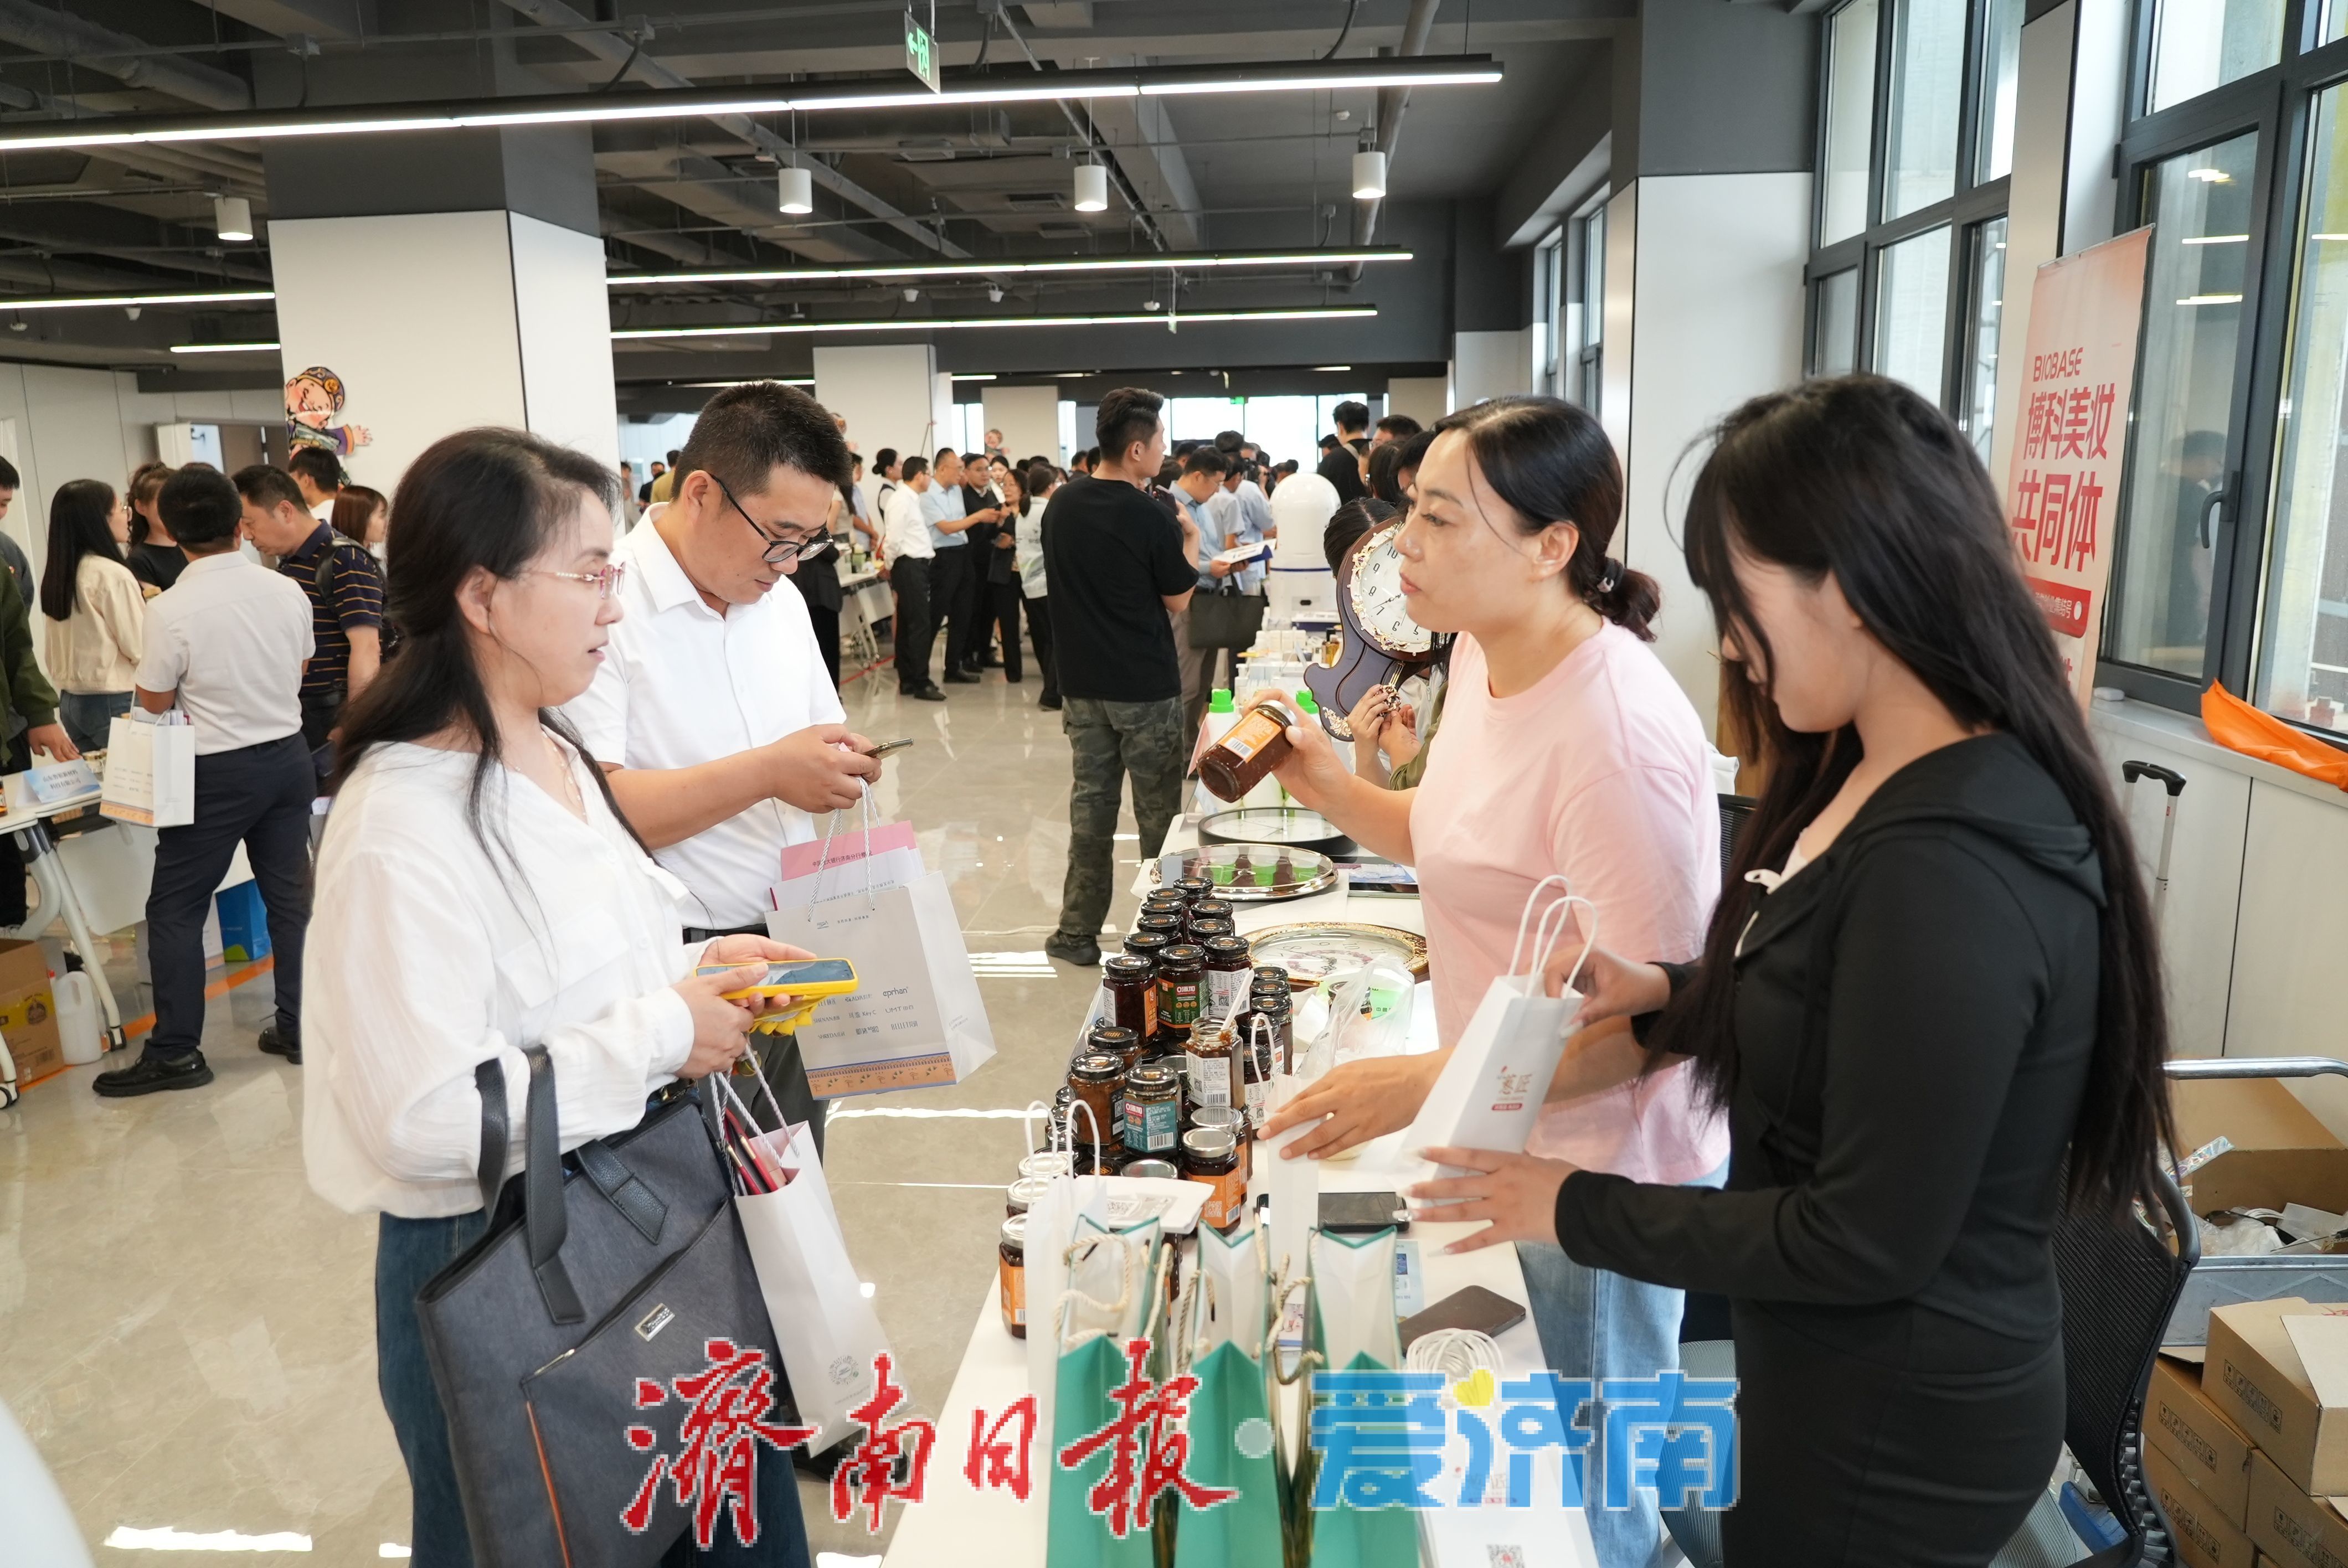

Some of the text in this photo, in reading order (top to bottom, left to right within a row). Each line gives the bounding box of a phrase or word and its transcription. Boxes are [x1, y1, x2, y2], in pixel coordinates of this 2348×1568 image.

[2033, 347, 2084, 383] BIOBASE
[2023, 383, 2115, 461] 博科美妆
[2011, 470, 2103, 572] 共同体
[1373, 563, 1381, 574] 9
[1368, 586, 1377, 596] 8
[1392, 621, 1400, 632] 6
